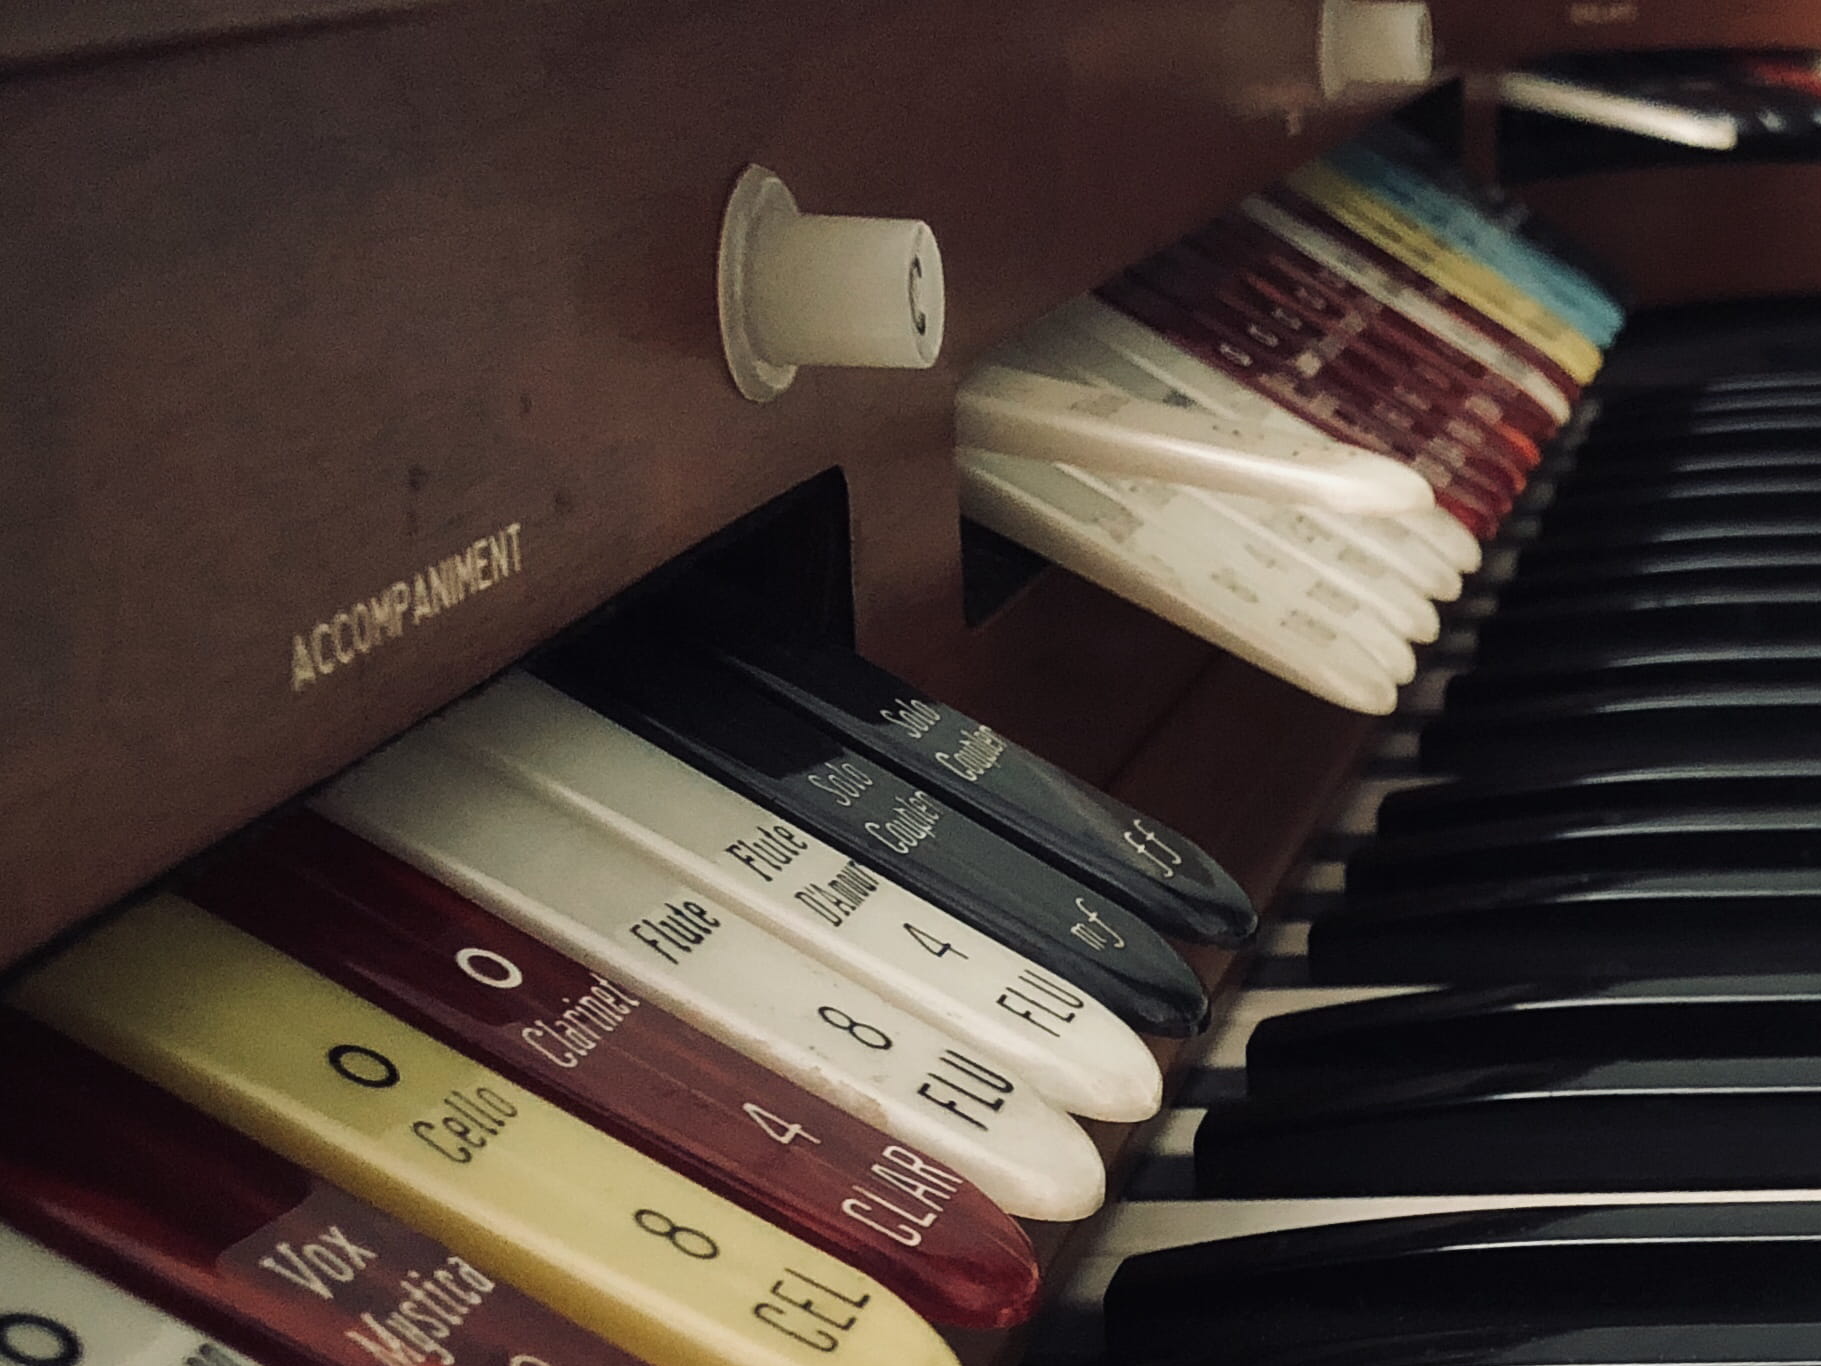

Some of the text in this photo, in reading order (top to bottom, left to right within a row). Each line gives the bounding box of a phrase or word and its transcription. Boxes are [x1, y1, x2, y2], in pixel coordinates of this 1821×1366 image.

[291, 522, 521, 692] ACCOMPANIMENT
[880, 698, 942, 739] Solo
[807, 761, 874, 808] Solo
[935, 723, 1008, 783] Coupler
[724, 825, 809, 883] Flute
[864, 789, 941, 855] Coupler
[794, 860, 881, 928] D'Amour
[1070, 897, 1127, 952] mf
[630, 897, 722, 965] Flute
[903, 922, 970, 960] 4
[521, 971, 640, 1069] Clarinet
[817, 1005, 894, 1051] 8
[996, 968, 1086, 1038] FLU
[742, 1102, 822, 1145] 4
[917, 1048, 1015, 1132] FLU
[411, 1085, 519, 1166] Cello
[841, 1144, 964, 1248] CLAR
[258, 1224, 378, 1302] Vox
[633, 1208, 721, 1261] 8
[752, 1266, 872, 1353] CEL
